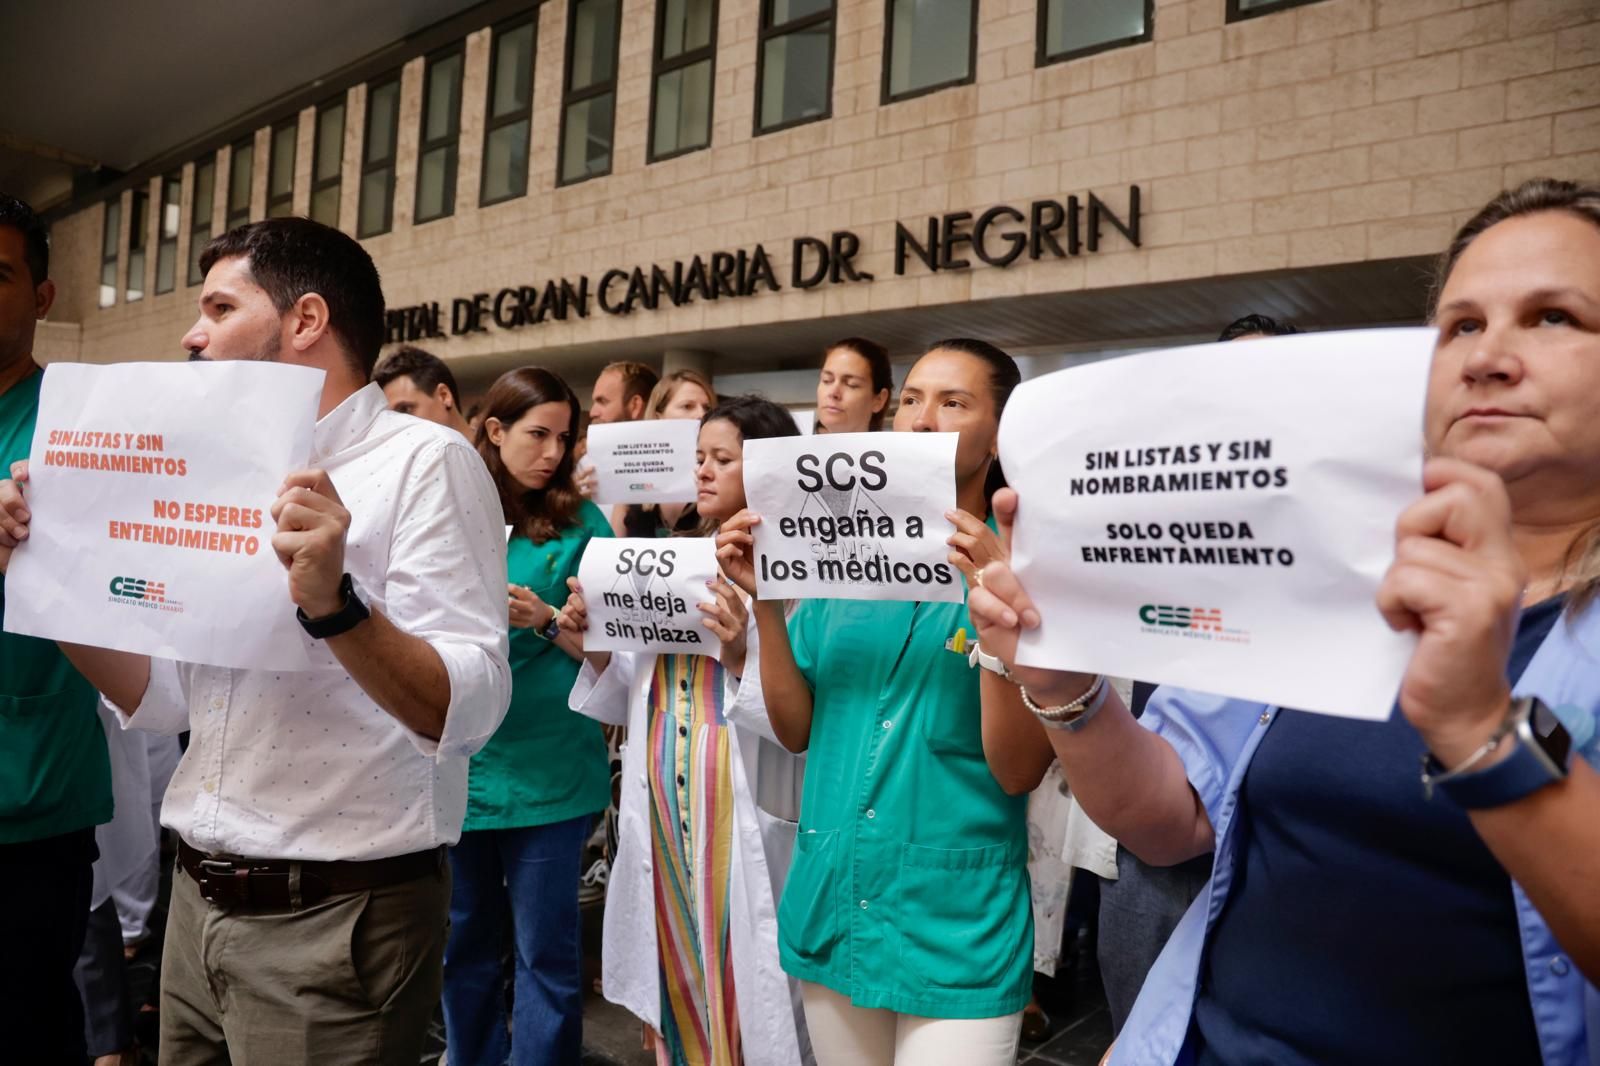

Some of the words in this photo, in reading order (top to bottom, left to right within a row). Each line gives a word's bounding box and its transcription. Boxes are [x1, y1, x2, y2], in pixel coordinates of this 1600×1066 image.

[384, 301, 446, 343] PITAL
[452, 293, 490, 336] DE
[493, 275, 592, 328] GRAN
[597, 243, 781, 315] CANARIA
[792, 231, 874, 289] DR.
[894, 184, 1141, 276] NEGRIN
[48, 430, 73, 445] SIN
[73, 431, 121, 449] LISTAS
[124, 433, 135, 450] Y
[136, 434, 164, 451] SIN
[1085, 450, 1119, 470] SIN
[1125, 444, 1202, 467] LISTAS
[1207, 443, 1221, 462] Y
[1227, 439, 1272, 461] SIN
[45, 450, 187, 477] NOMBRAMIENTOS
[796, 450, 888, 493] SCS
[1070, 467, 1288, 496] NOMBRAMIENTOS
[153, 500, 181, 520] NO
[184, 503, 263, 529] ESPERES
[779, 509, 895, 544] engaña
[905, 515, 924, 538] a
[108, 520, 260, 556] ENTENDIMIENTO
[1106, 523, 1163, 540] SOLO
[1168, 522, 1254, 544] QUEDA
[615, 548, 677, 578] SCS
[761, 554, 808, 581] los
[817, 554, 953, 585] médicos
[1081, 546, 1294, 567] ENFRENTAMIENTO
[108, 597, 137, 606] SINDICATO
[109, 576, 165, 603] CESM
[603, 591, 635, 609] me
[640, 590, 687, 617] deja
[605, 618, 636, 638] sin
[640, 622, 702, 645] plaza
[1139, 605, 1222, 631] CESM
